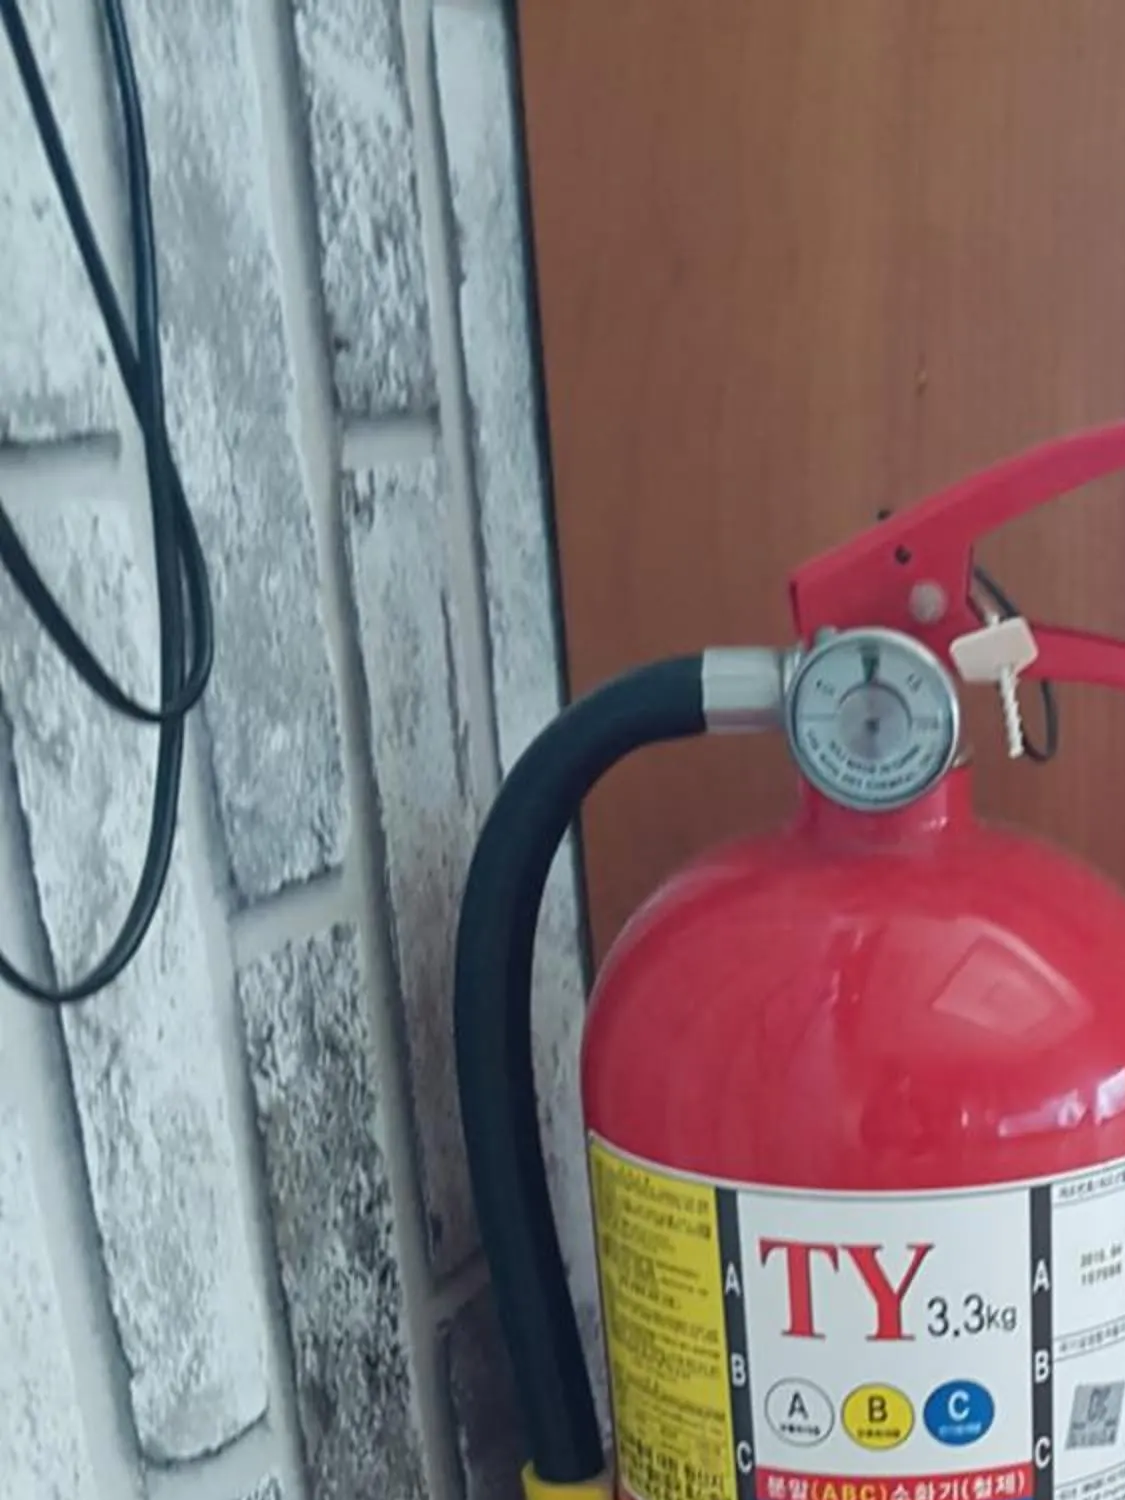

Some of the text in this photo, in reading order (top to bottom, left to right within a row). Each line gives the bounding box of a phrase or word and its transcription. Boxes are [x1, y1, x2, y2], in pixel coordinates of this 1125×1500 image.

[724, 1264, 740, 1296] A
[759, 1237, 1017, 1341] TY 3.3kg
[1033, 1260, 1049, 1293] A
[731, 1353, 746, 1386] B
[1035, 1350, 1049, 1382] B
[787, 1392, 808, 1420] A
[868, 1396, 888, 1423] B
[948, 1390, 969, 1421] C
[737, 1440, 752, 1474] C
[1034, 1437, 1050, 1469] C
